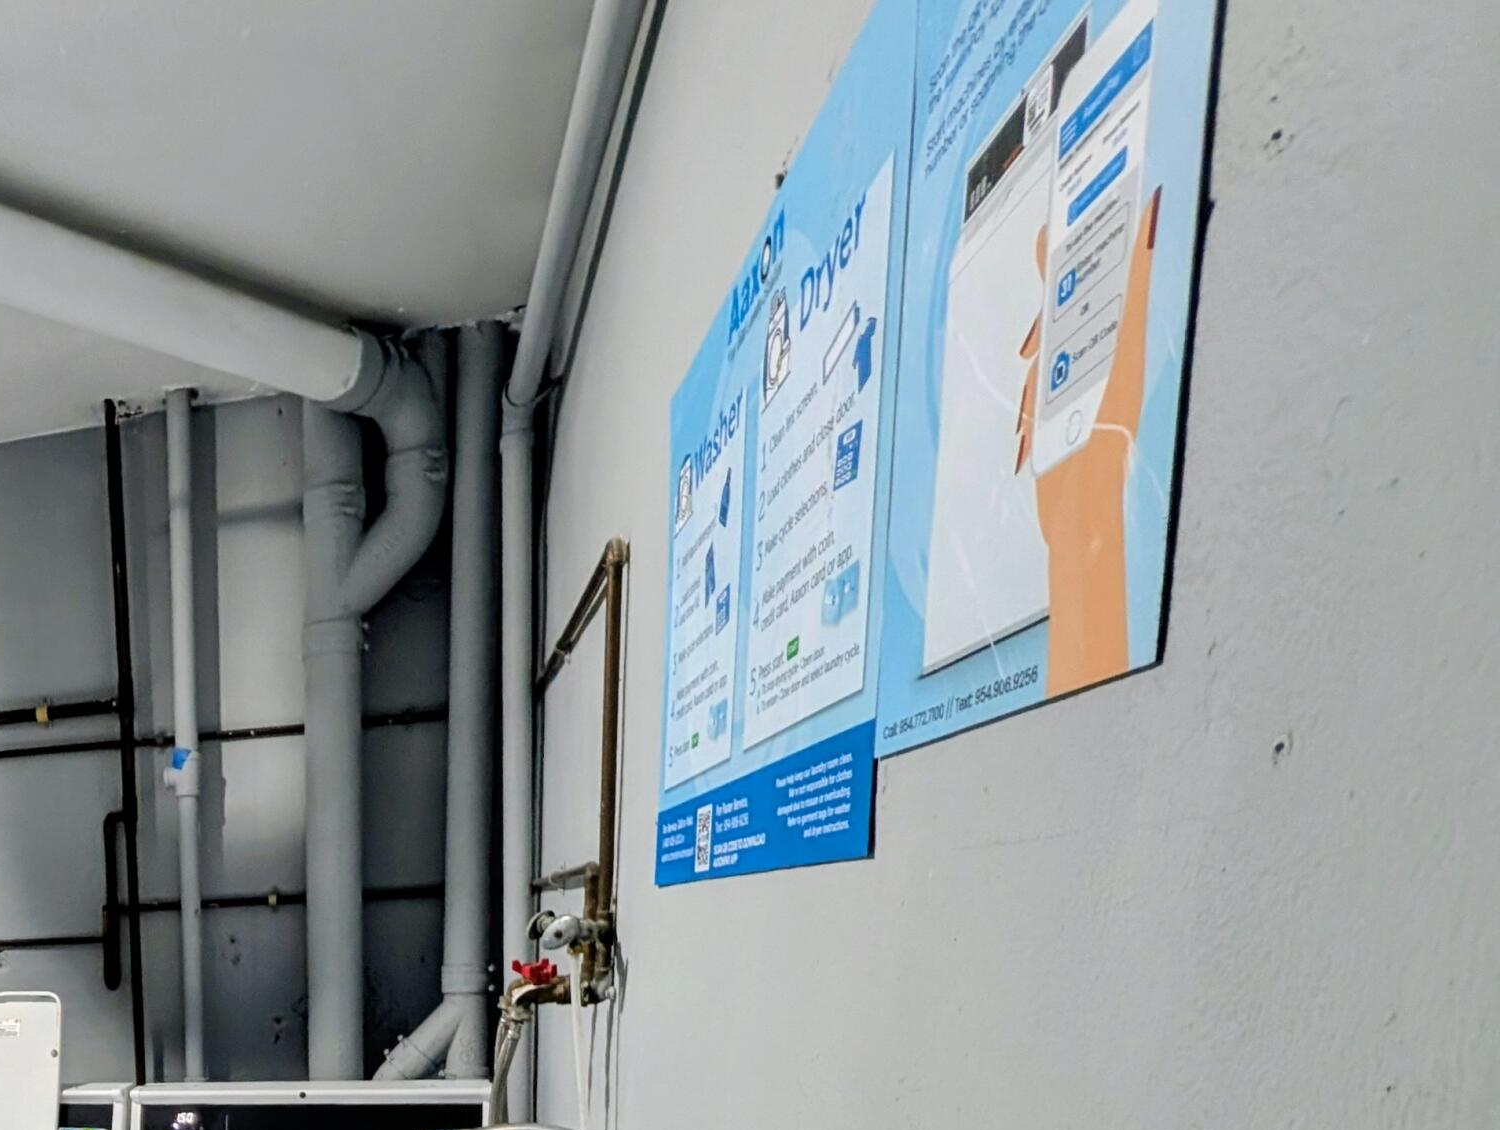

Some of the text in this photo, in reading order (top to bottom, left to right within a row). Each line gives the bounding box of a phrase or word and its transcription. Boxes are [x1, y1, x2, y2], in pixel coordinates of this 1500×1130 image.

[727, 206, 785, 346] Aaxon
[800, 191, 866, 332] Dryer
[694, 387, 743, 490] Washer
[749, 666, 757, 696] 5
[974, 664, 1039, 706] 954.906.9256
